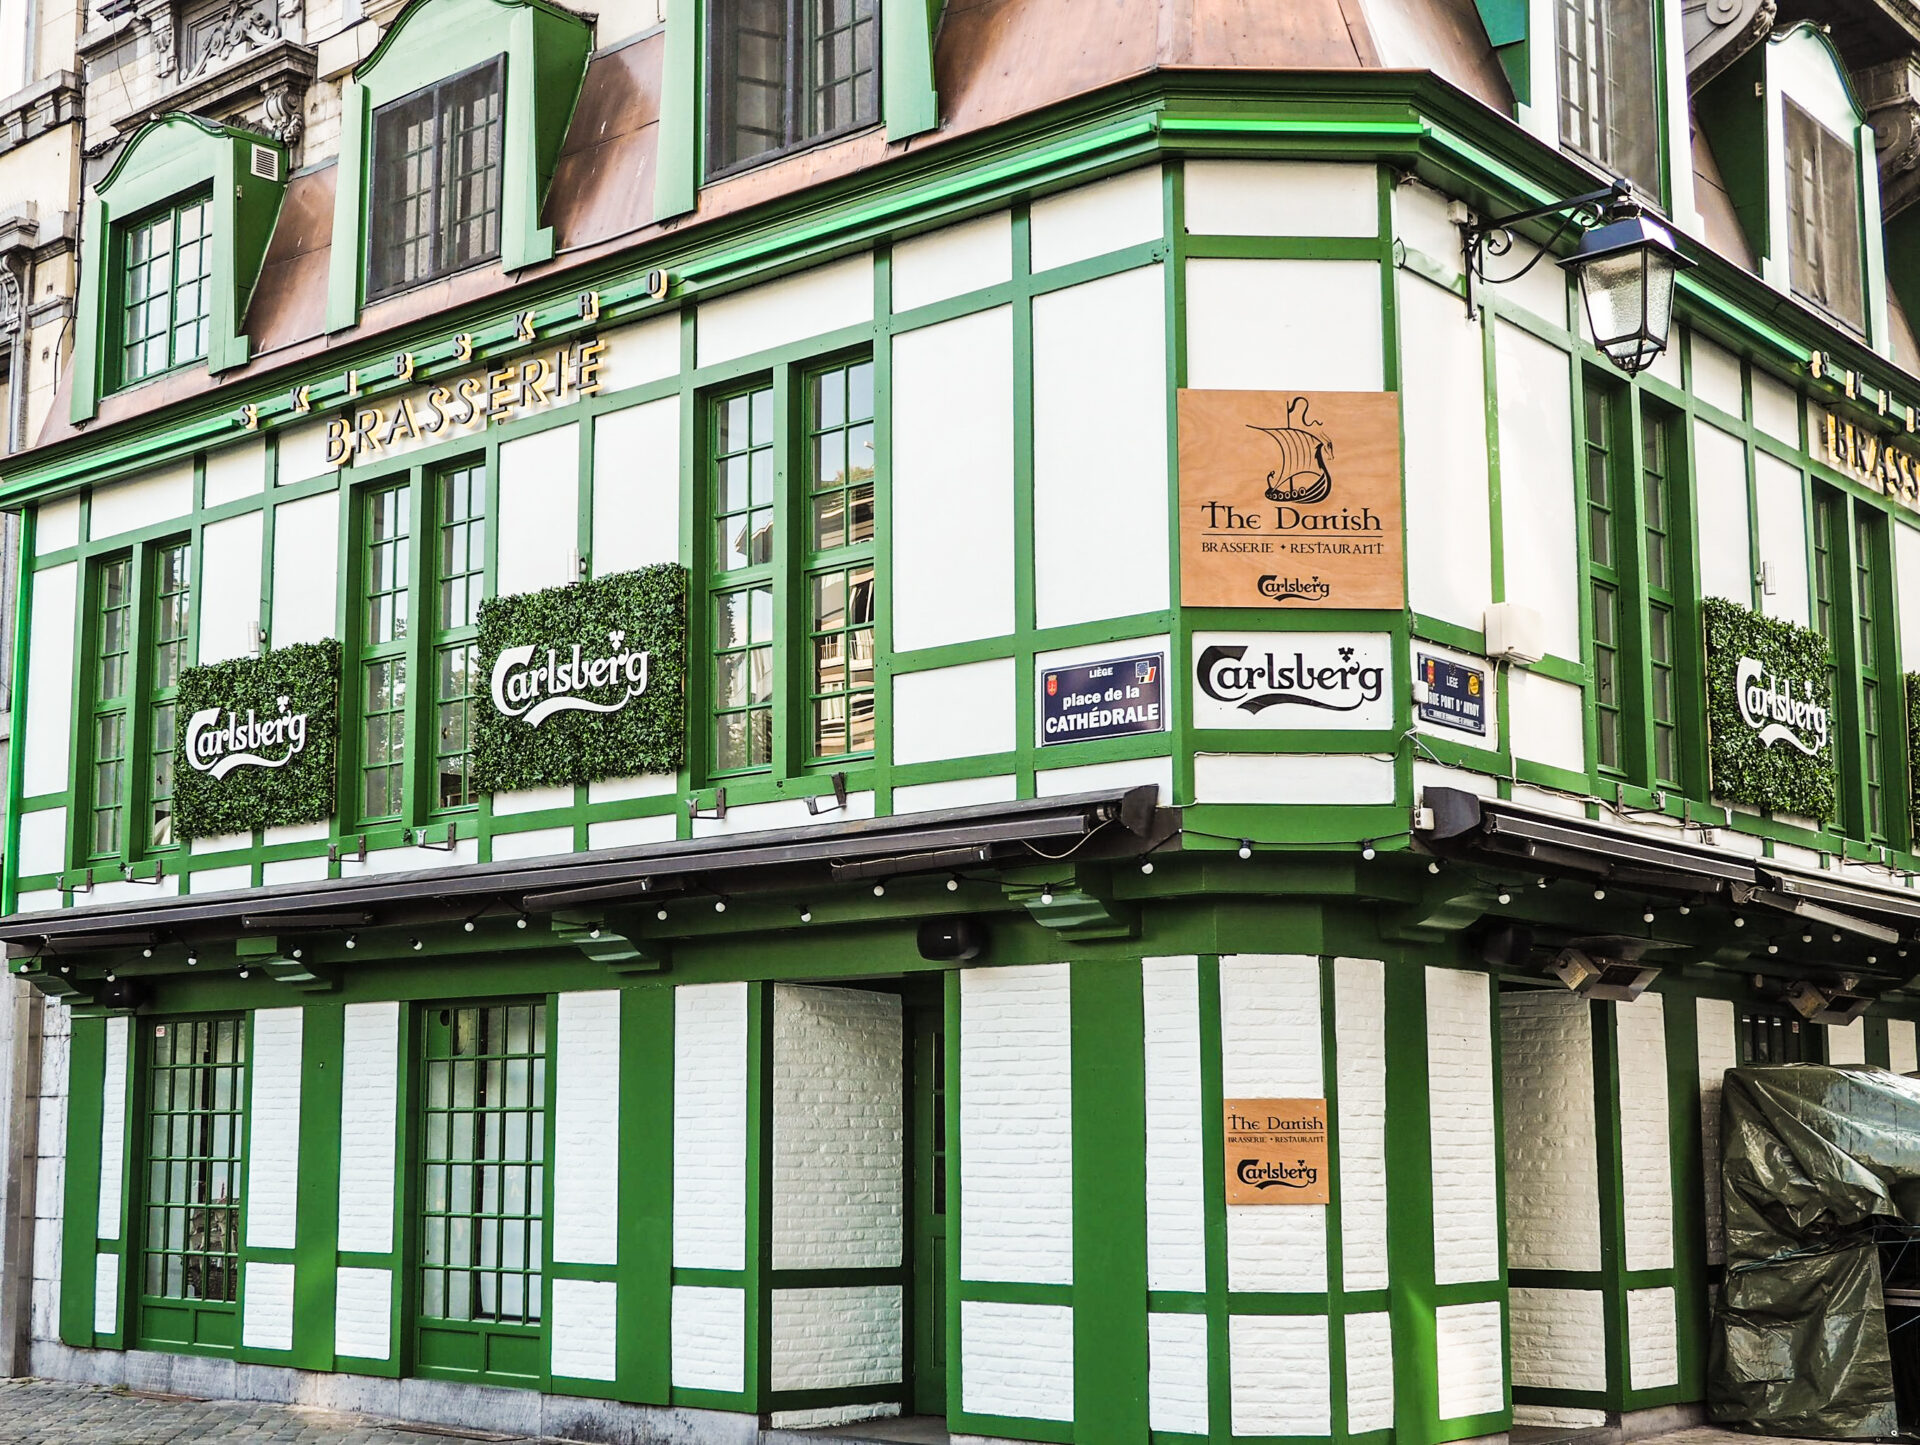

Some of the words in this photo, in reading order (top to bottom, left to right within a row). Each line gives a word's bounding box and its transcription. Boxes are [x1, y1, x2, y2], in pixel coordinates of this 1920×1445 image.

[326, 339, 606, 466] BRASSERIE
[1825, 413, 1920, 506] BRASS
[1201, 501, 1262, 530] The
[1275, 507, 1383, 531] Danish
[1201, 542, 1274, 553] BRASSERIE
[1290, 542, 1384, 554] RESTAURANT
[1257, 575, 1330, 602] Carlsberg
[491, 640, 651, 728] Carlsberg
[1089, 667, 1114, 679] LIÈGE
[1196, 645, 1384, 715] Carlsberg
[1063, 693, 1101, 710] place
[1104, 688, 1122, 702] de
[1126, 685, 1140, 699] la
[1736, 656, 1827, 757] Carlsberg
[1045, 703, 1159, 734] CATHÉDRALE
[186, 701, 308, 781] Carlsberg
[1227, 1114, 1261, 1130] The
[1267, 1116, 1324, 1130] Danish
[1237, 1159, 1318, 1190] Carlsberg
